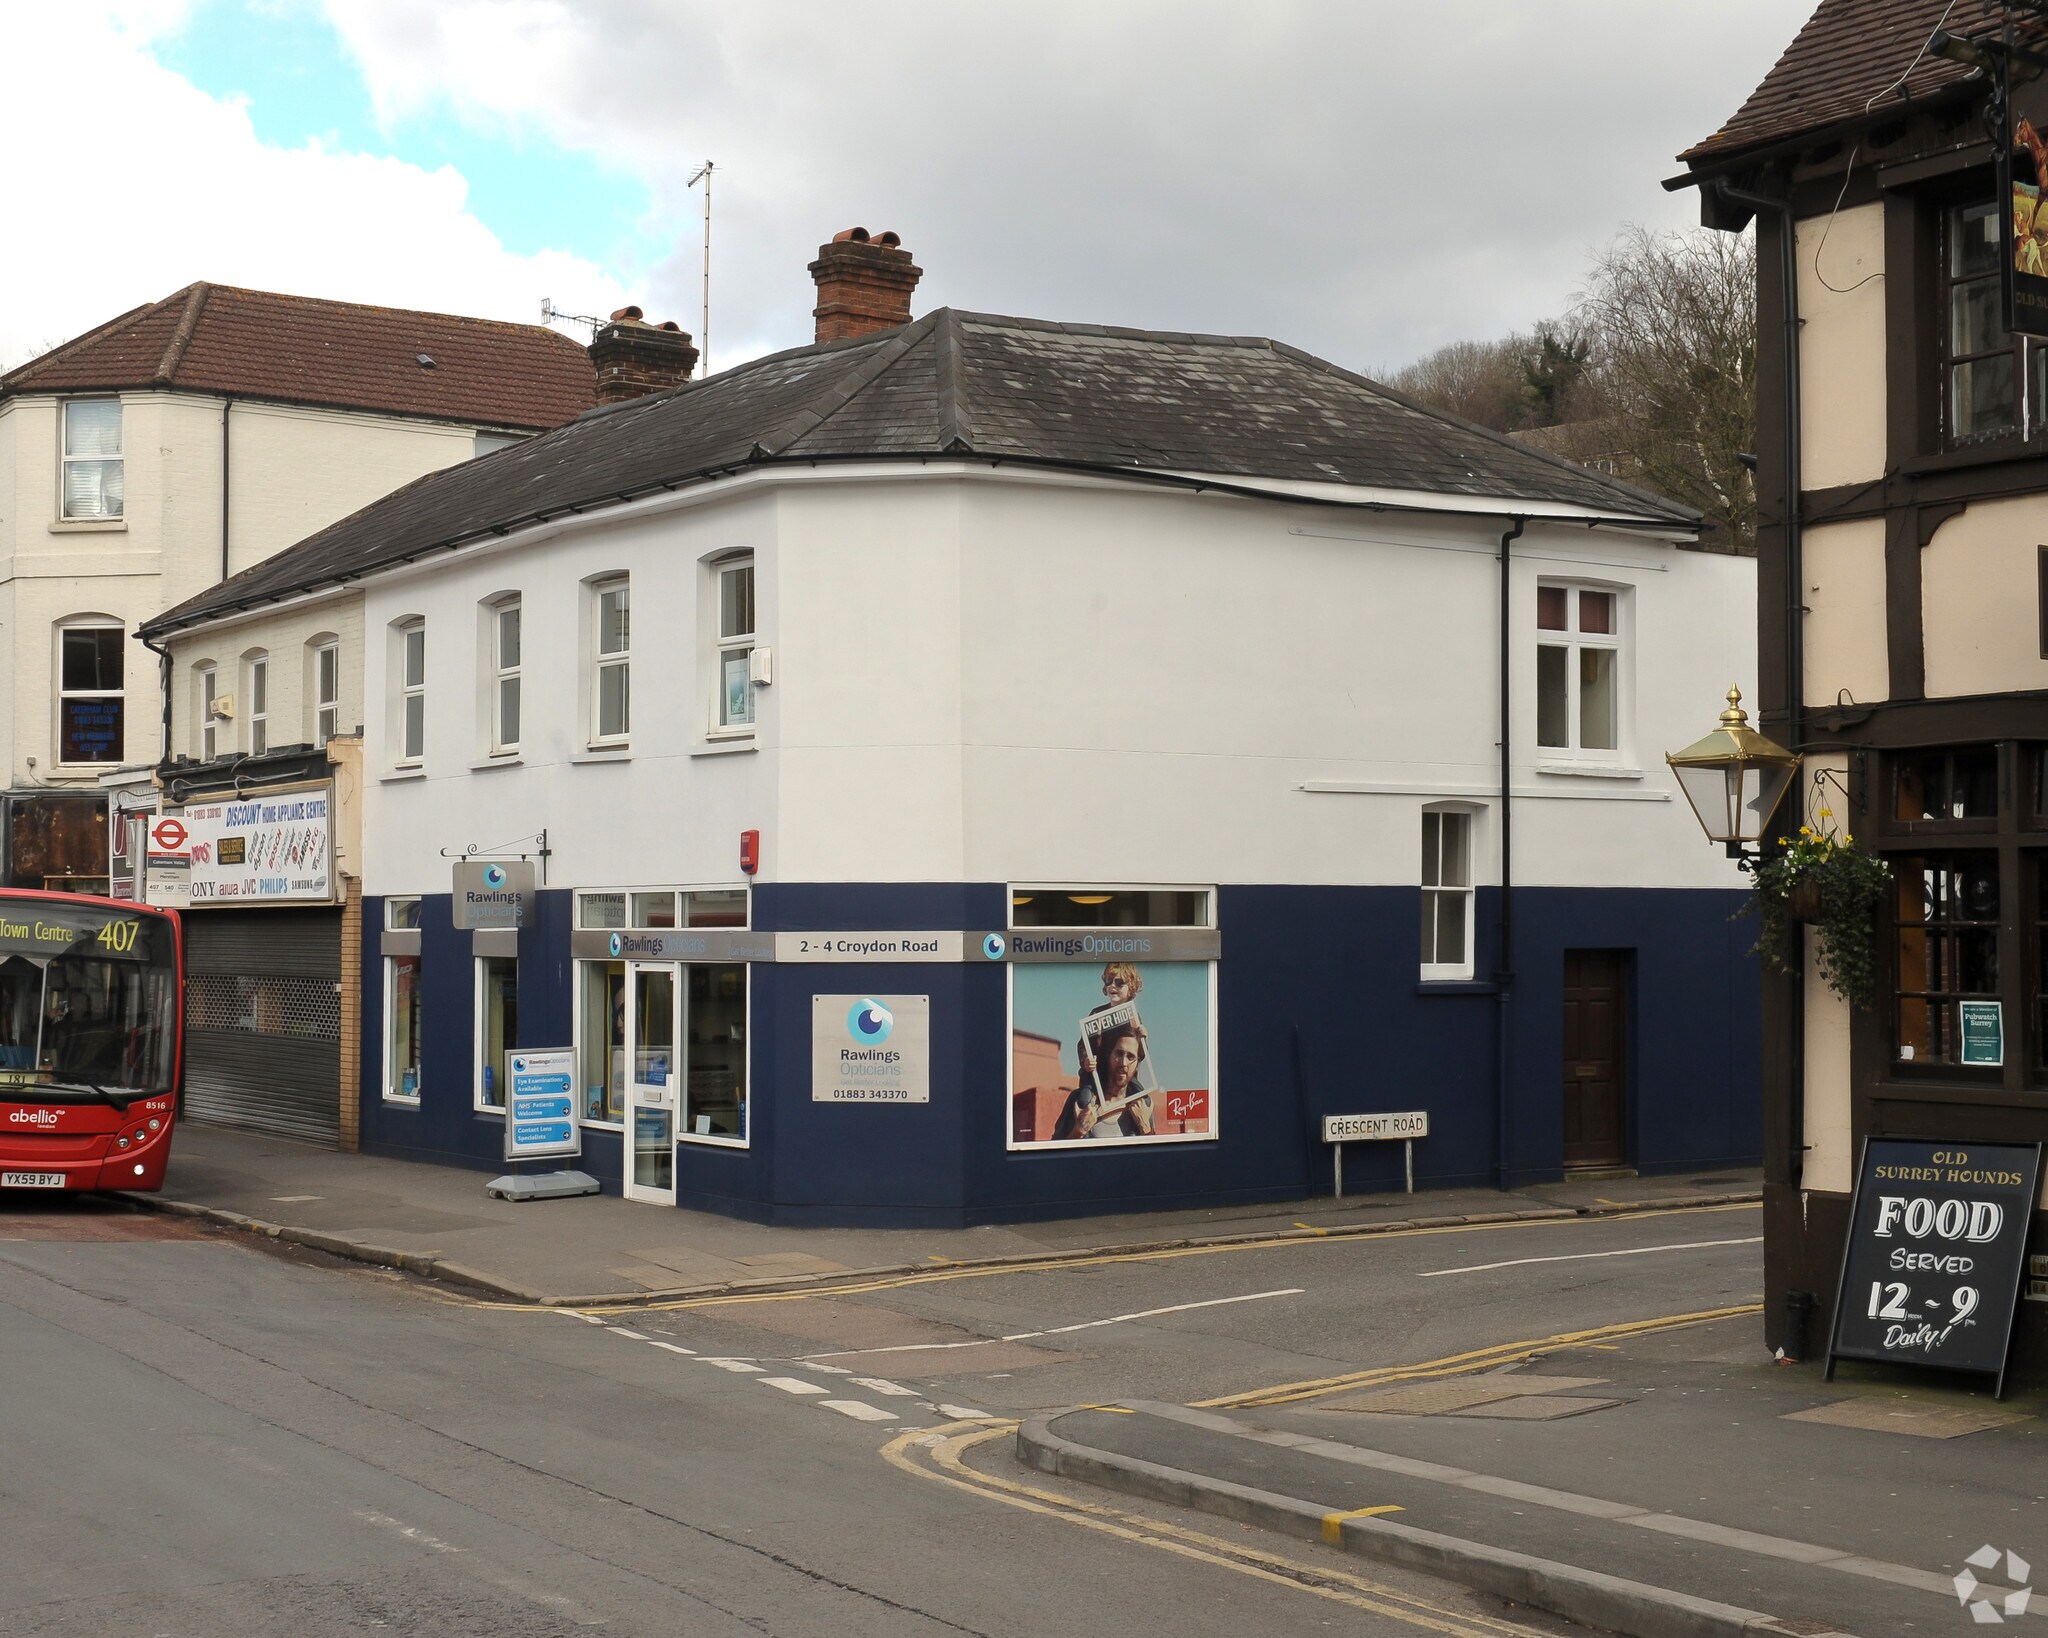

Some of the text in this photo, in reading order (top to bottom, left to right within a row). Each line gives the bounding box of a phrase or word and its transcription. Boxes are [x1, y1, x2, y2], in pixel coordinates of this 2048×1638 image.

[2016, 292, 2034, 305] OLD
[226, 800, 326, 827] DISCOUNT HOME APPLIANCE CENTRE
[269, 828, 282, 869] BOSCH
[298, 827, 312, 871] ZANUSSI
[309, 827, 319, 856] AEG
[254, 833, 266, 871] dyson
[190, 882, 215, 897] ONY
[220, 883, 239, 896] aiwa
[242, 879, 256, 894] JVC
[260, 878, 288, 894] PHILIPS
[292, 879, 313, 890] SAMSUNG
[466, 891, 522, 904] Rawlings
[468, 905, 523, 919] Opticians
[0, 919, 140, 951] Town Centre 407
[623, 936, 663, 955] Rawlings
[664, 934, 704, 954] Opticians
[800, 941, 808, 952] 2
[824, 941, 832, 952] 4
[837, 940, 896, 954] Croydon
[902, 940, 938, 952] Road
[1012, 935, 1150, 958] Rawlings Opticians
[1085, 1006, 1134, 1035] NEVER HIDE
[841, 1049, 900, 1063] Rawlings
[8, 1074, 26, 1084] 181
[840, 1063, 900, 1077] Opticians
[833, 1090, 908, 1099] 01883 343370
[1168, 1092, 1204, 1116] Ray-Ban
[10, 1109, 57, 1124] abellio
[1330, 1118, 1423, 1135] CRESCENT ROAD
[1933, 1152, 1968, 1164] OLD
[7, 1174, 61, 1185] YX59 BYJ
[1875, 1166, 2023, 1185] SURREY HOUNDS
[1873, 1196, 2004, 1243] FOOD
[1890, 1248, 1974, 1275] SERVED
[1868, 1282, 1911, 1321] 12
[1949, 1286, 1979, 1325] 9
[1883, 1323, 1952, 1353] Daily!
